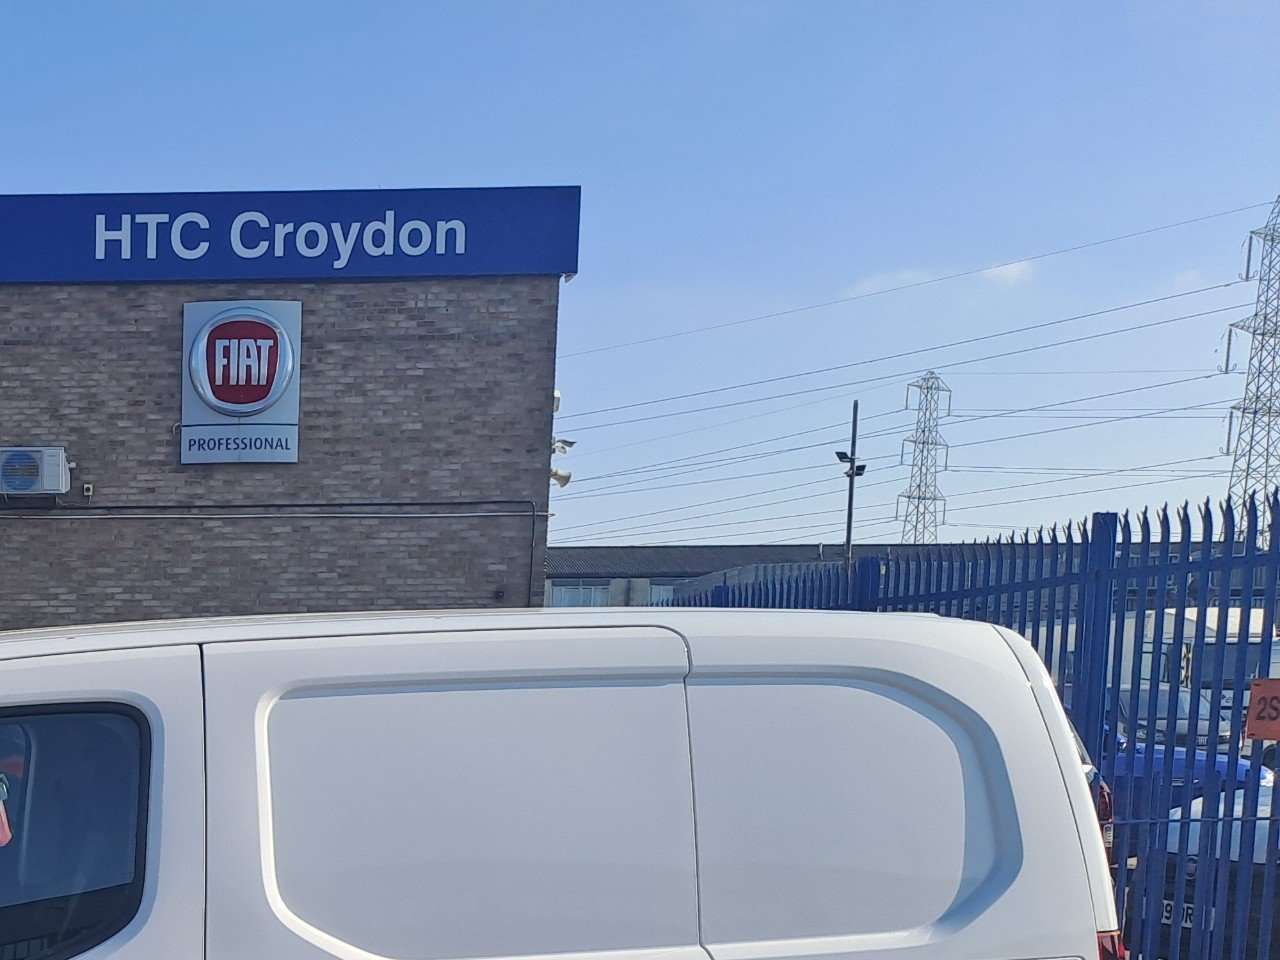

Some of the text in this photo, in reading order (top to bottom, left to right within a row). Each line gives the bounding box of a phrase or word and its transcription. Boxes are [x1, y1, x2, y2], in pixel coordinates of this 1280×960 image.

[95, 210, 466, 269] HTC Croydon
[215, 338, 274, 386] FIAT
[188, 437, 291, 452] PROFESSIONAL
